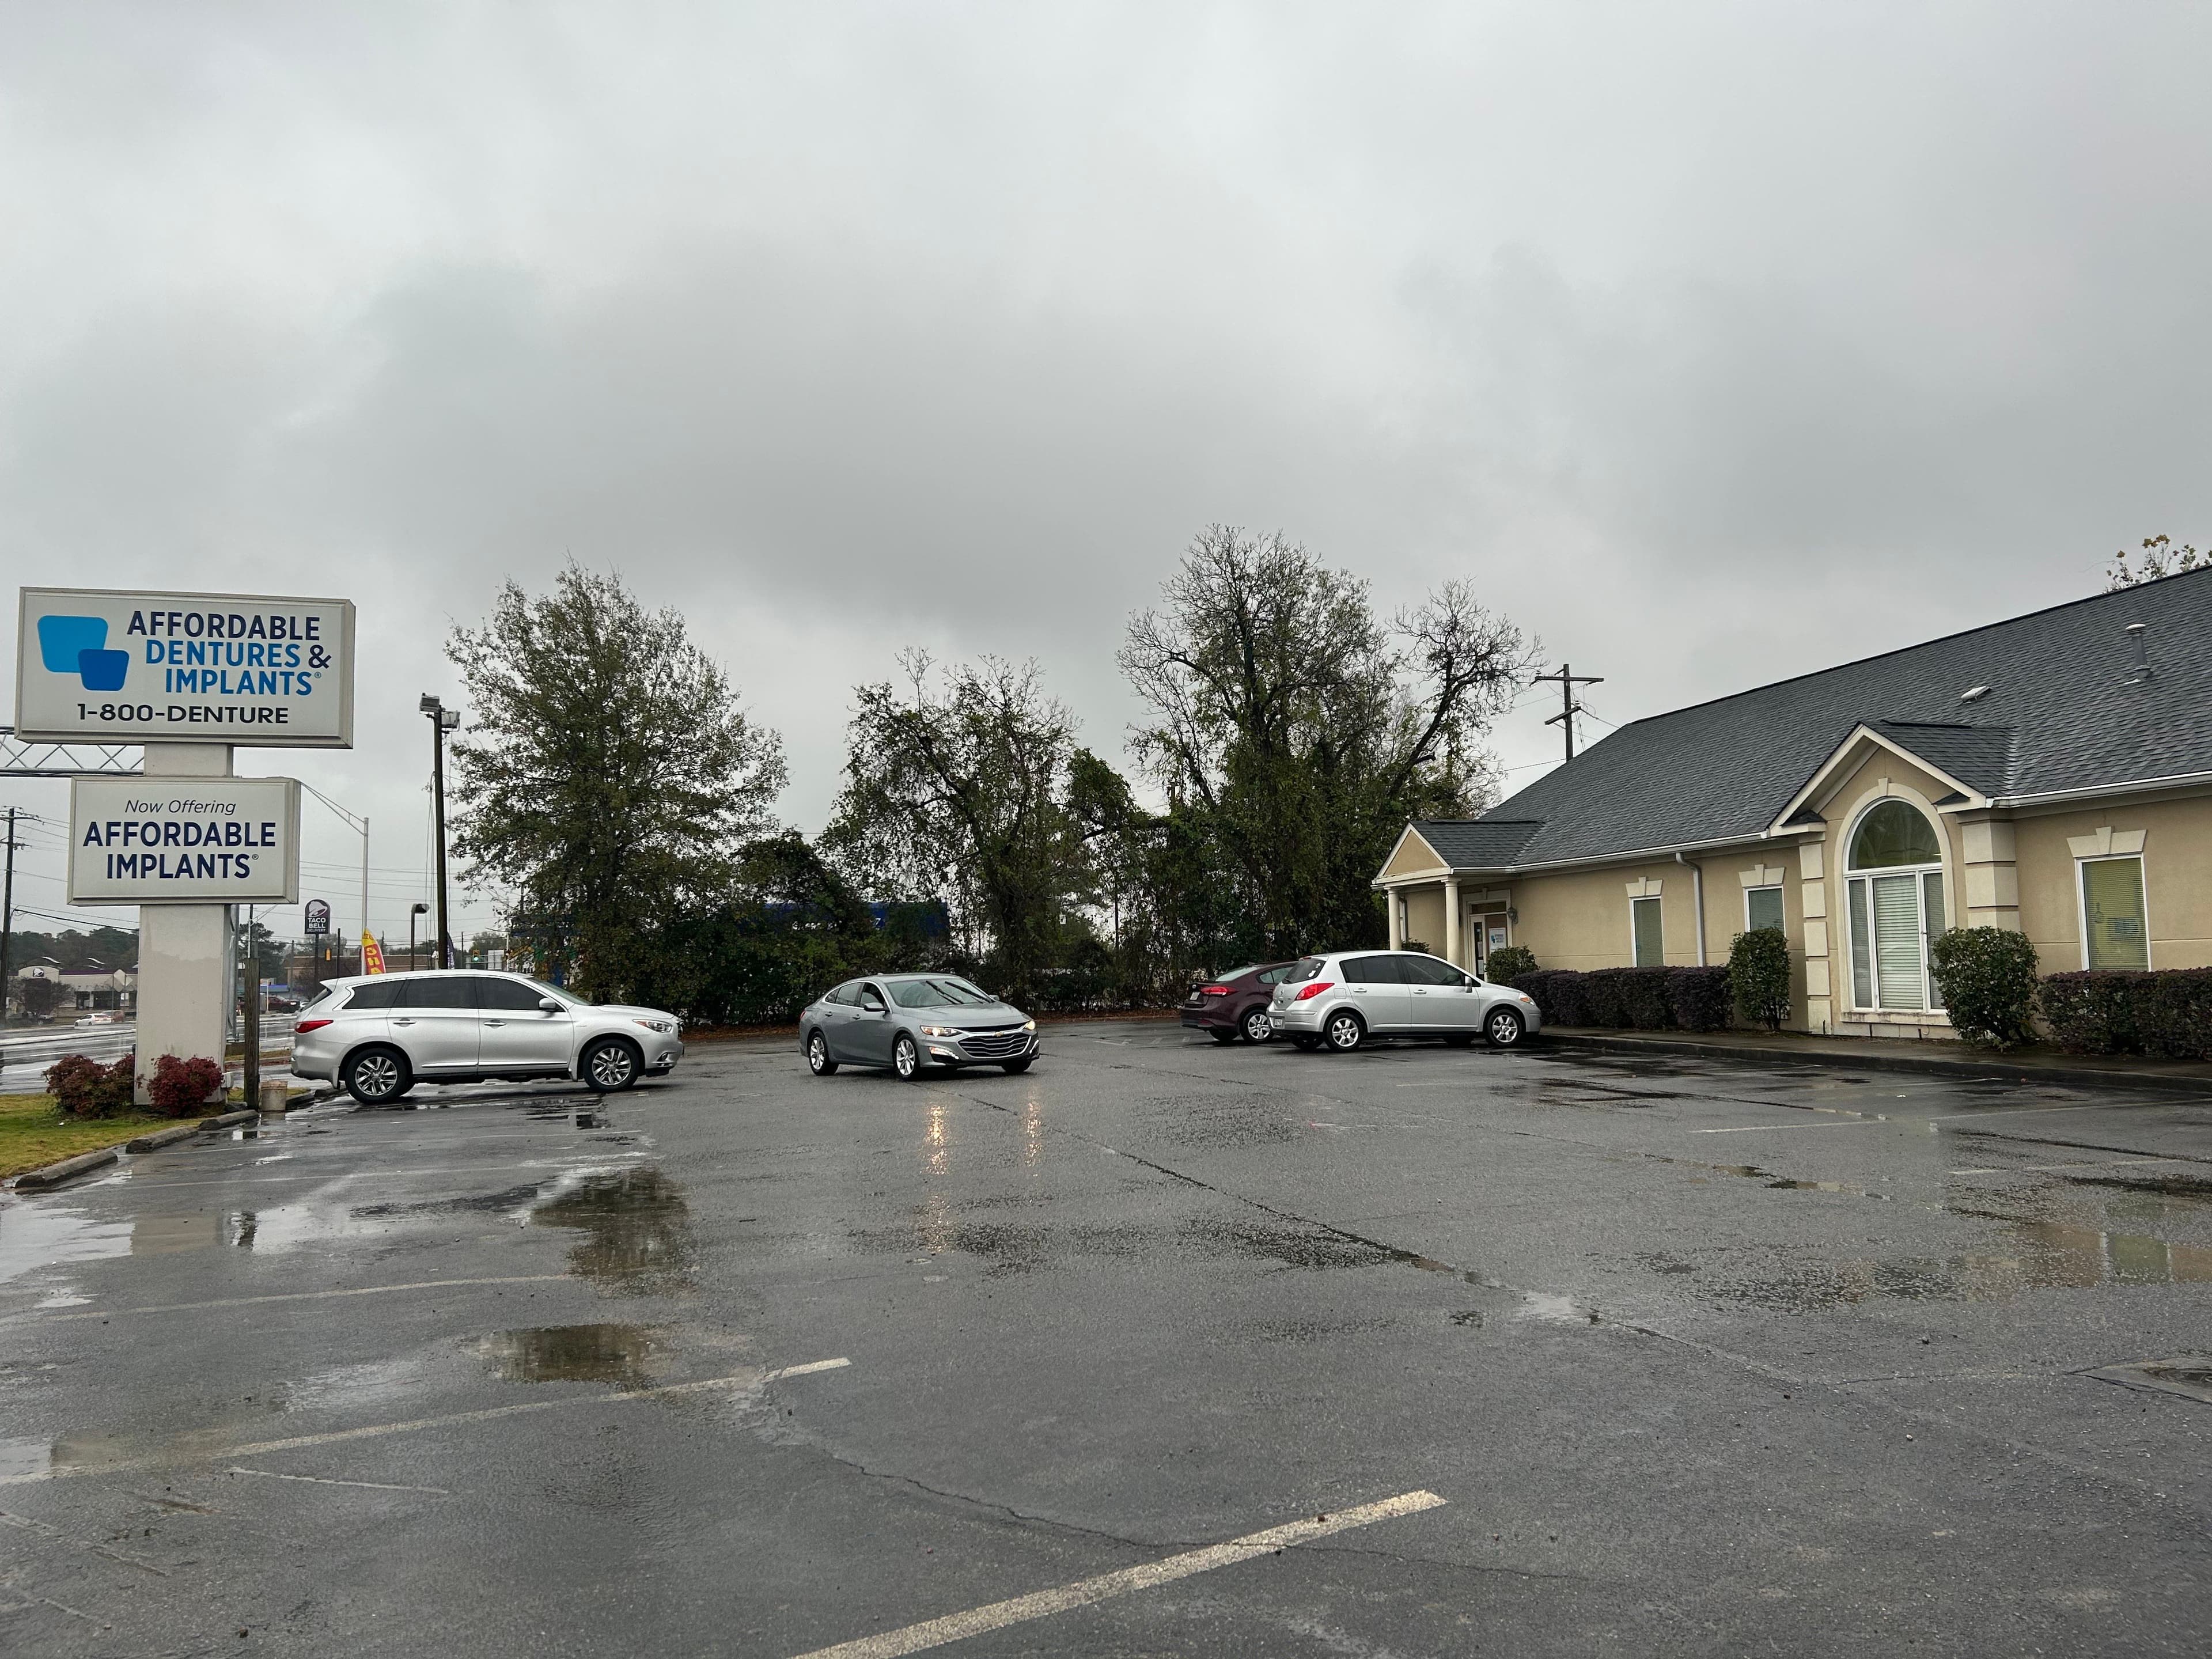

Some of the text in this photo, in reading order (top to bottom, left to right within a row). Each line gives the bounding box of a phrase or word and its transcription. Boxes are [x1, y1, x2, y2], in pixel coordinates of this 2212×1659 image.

[127, 611, 320, 641] AFFORDABLE
[146, 639, 332, 669] DENTURES &
[77, 703, 289, 724] 1-800-DENTURE
[125, 800, 236, 816] Now Offering
[83, 821, 276, 847] AFFORDABLE
